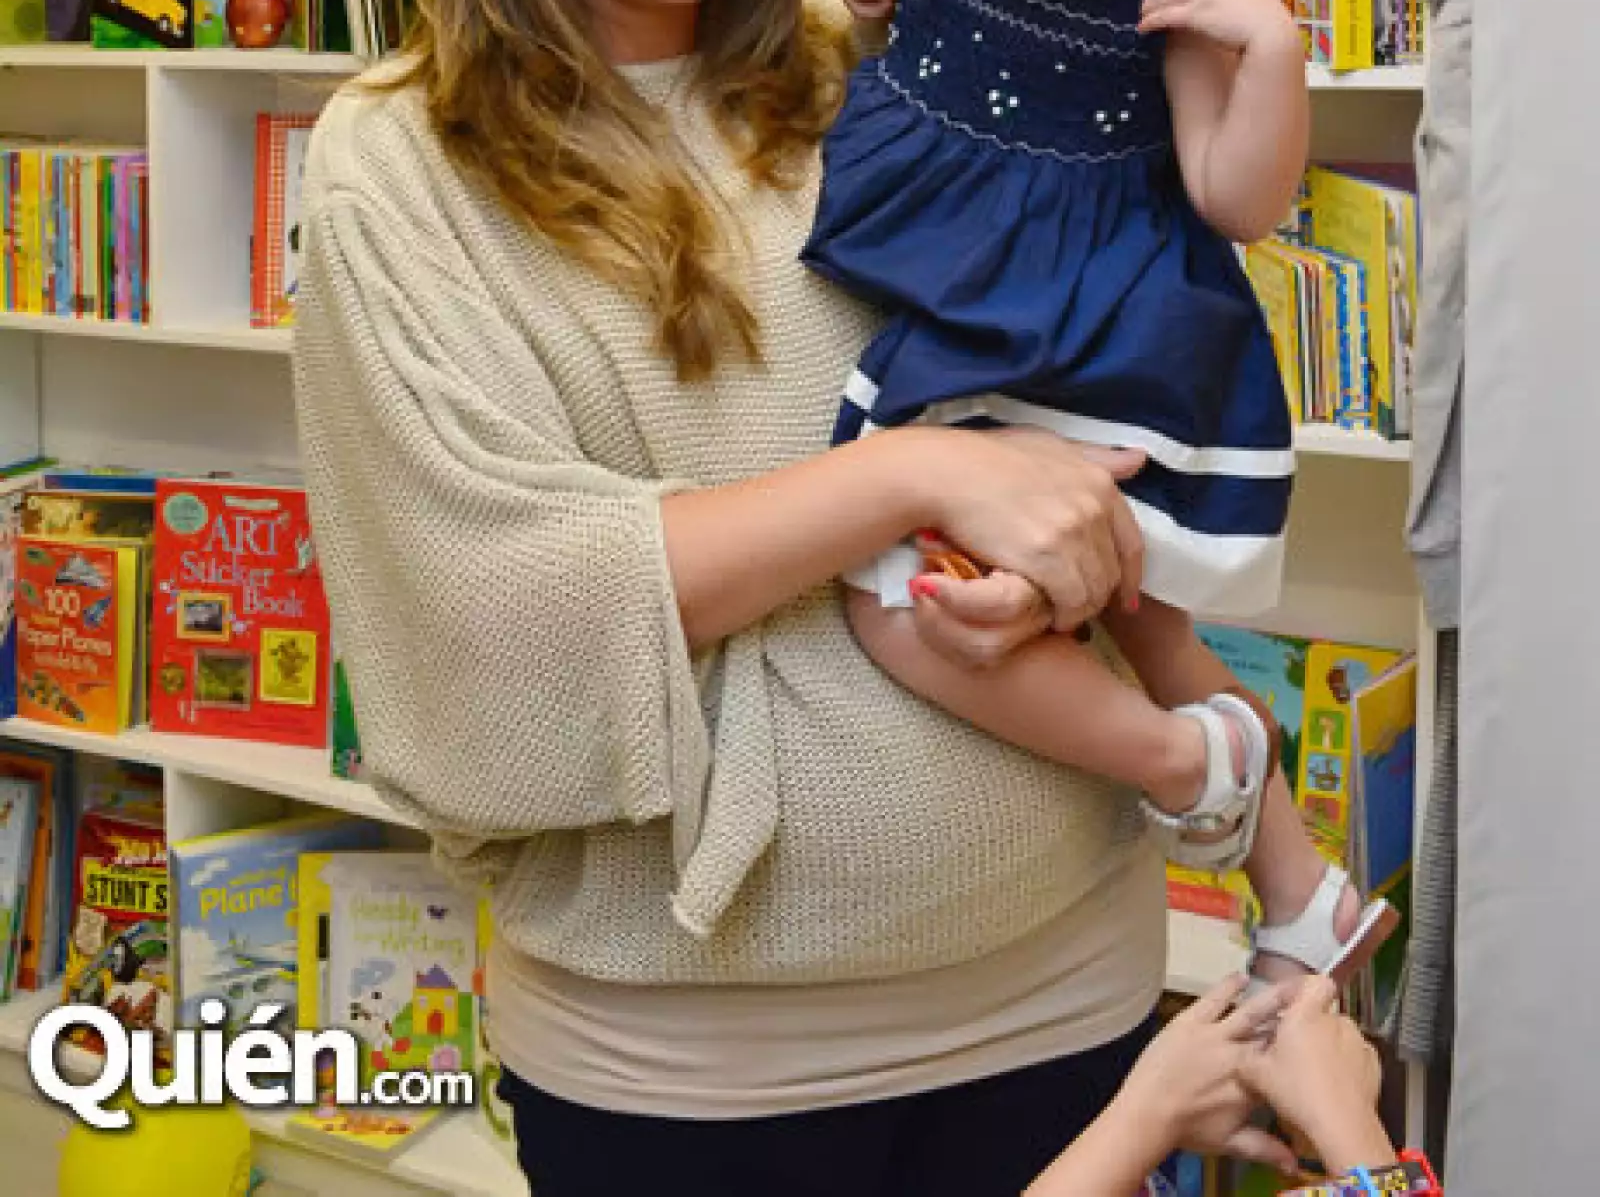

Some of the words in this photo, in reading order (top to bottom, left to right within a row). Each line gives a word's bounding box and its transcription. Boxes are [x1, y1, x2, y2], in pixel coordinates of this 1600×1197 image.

[202, 514, 279, 556] ART
[180, 550, 275, 588] Sticker
[45, 588, 81, 618] 100
[242, 585, 304, 618] Book
[86, 871, 151, 912] STUNT
[155, 883, 168, 911] S
